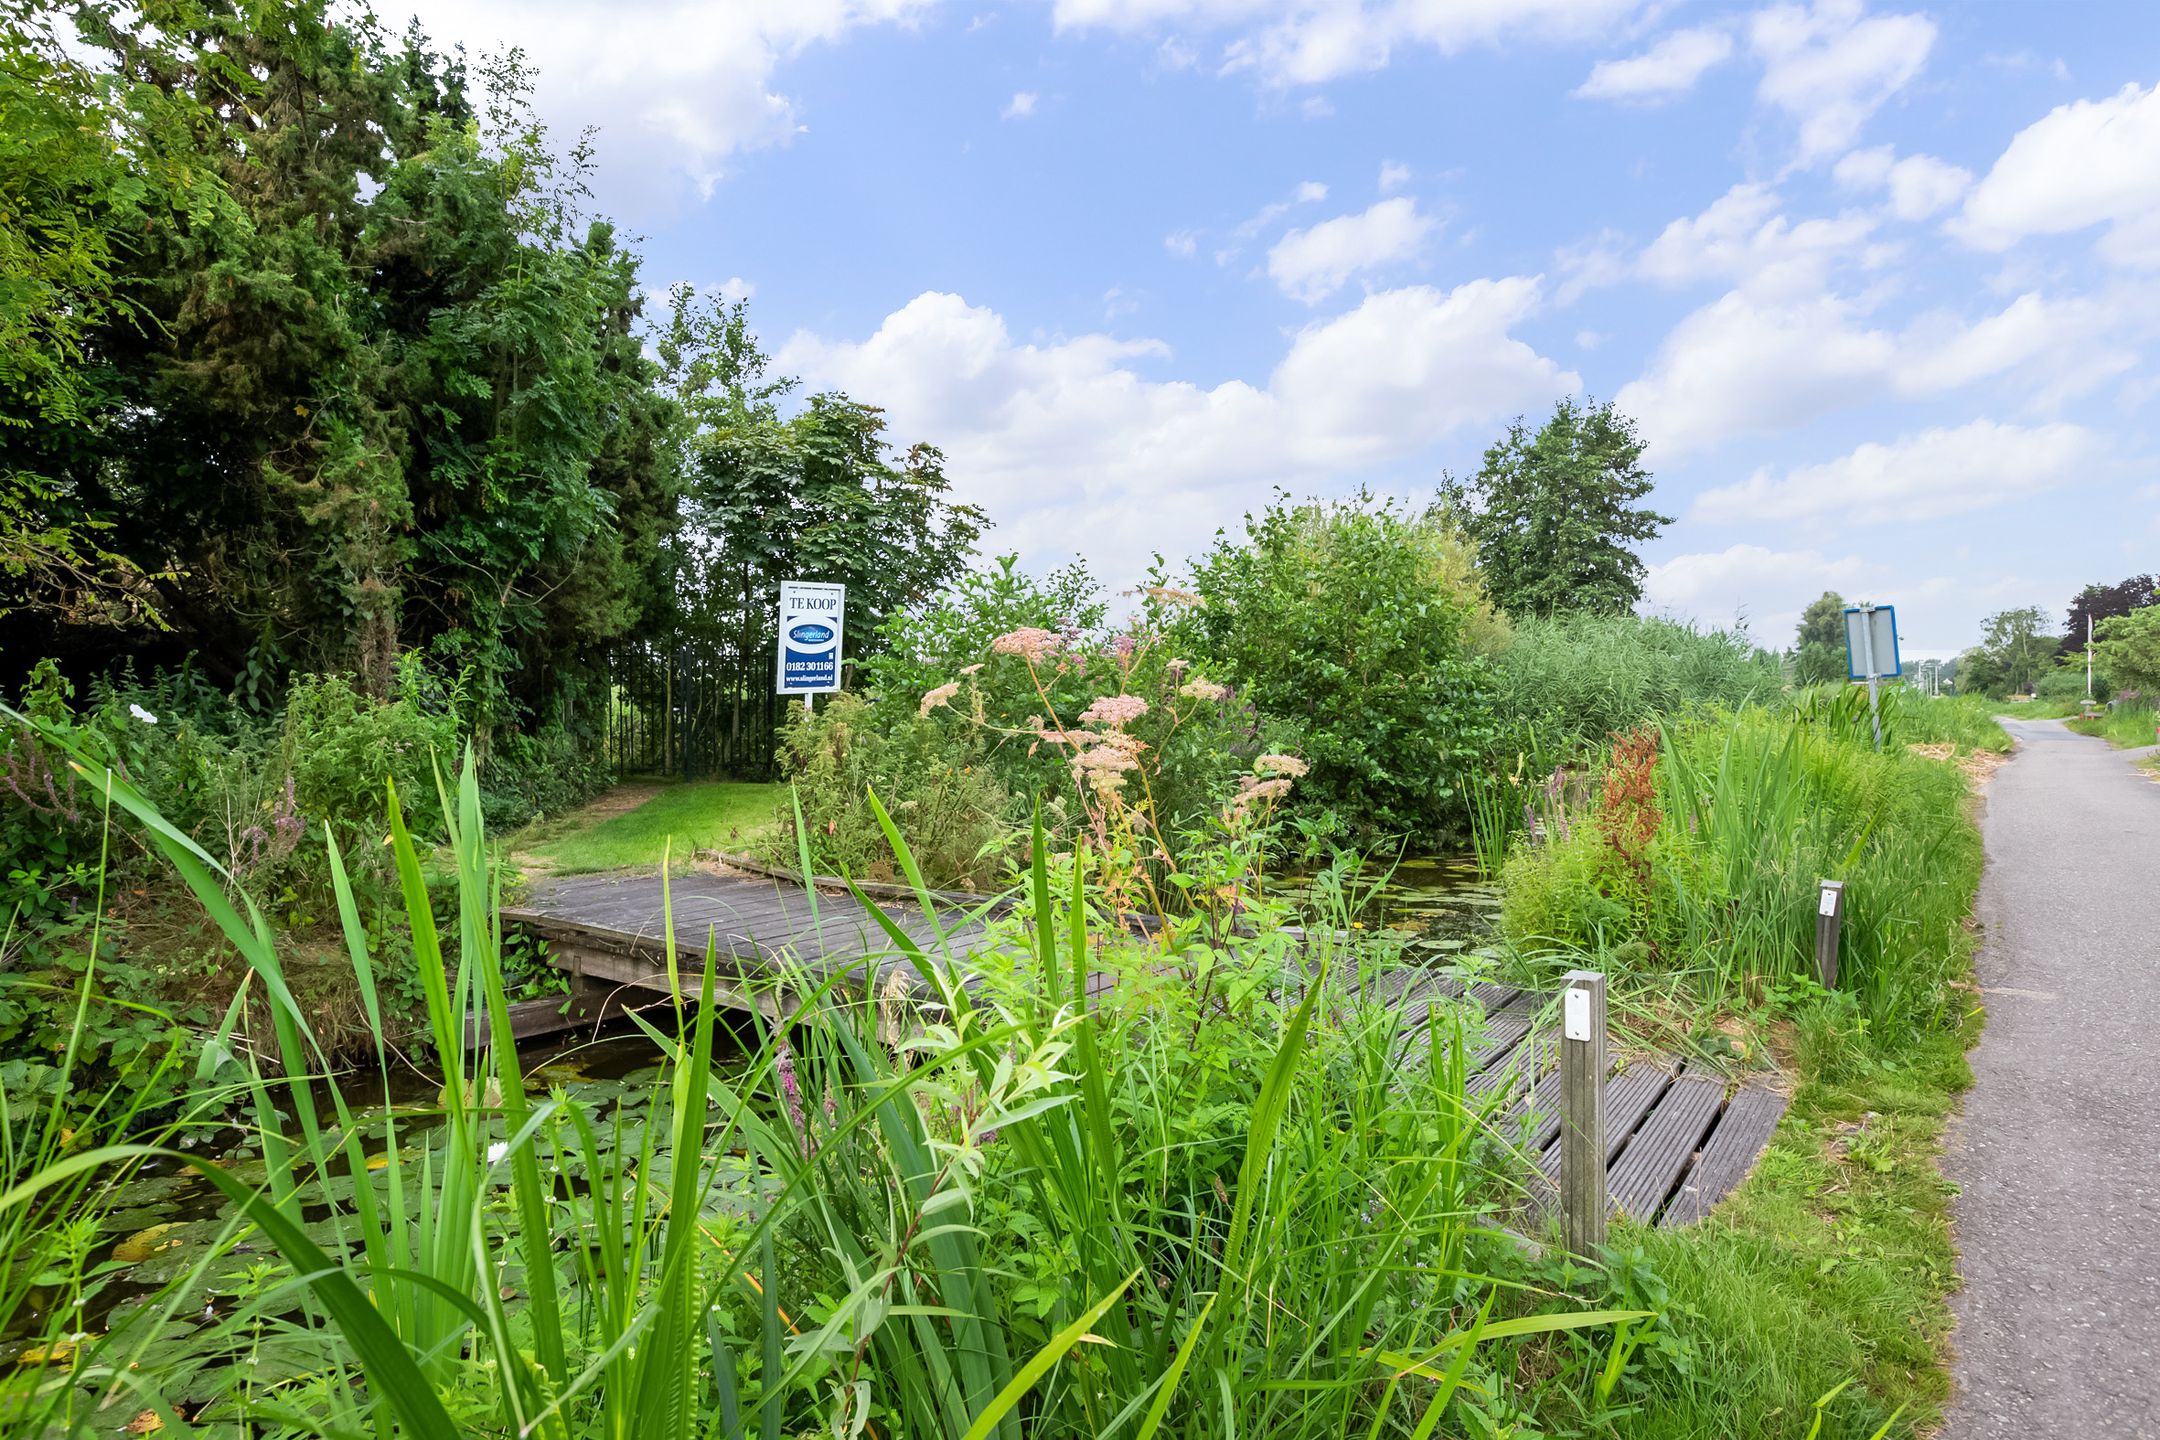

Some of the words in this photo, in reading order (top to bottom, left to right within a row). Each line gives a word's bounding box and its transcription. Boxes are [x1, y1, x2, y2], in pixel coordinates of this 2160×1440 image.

[790, 597, 804, 609] TE
[806, 598, 837, 610] KOOP
[793, 629, 830, 641] Slingerland
[786, 662, 805, 671] 0182
[786, 674, 832, 682] www.slingerland.nl
